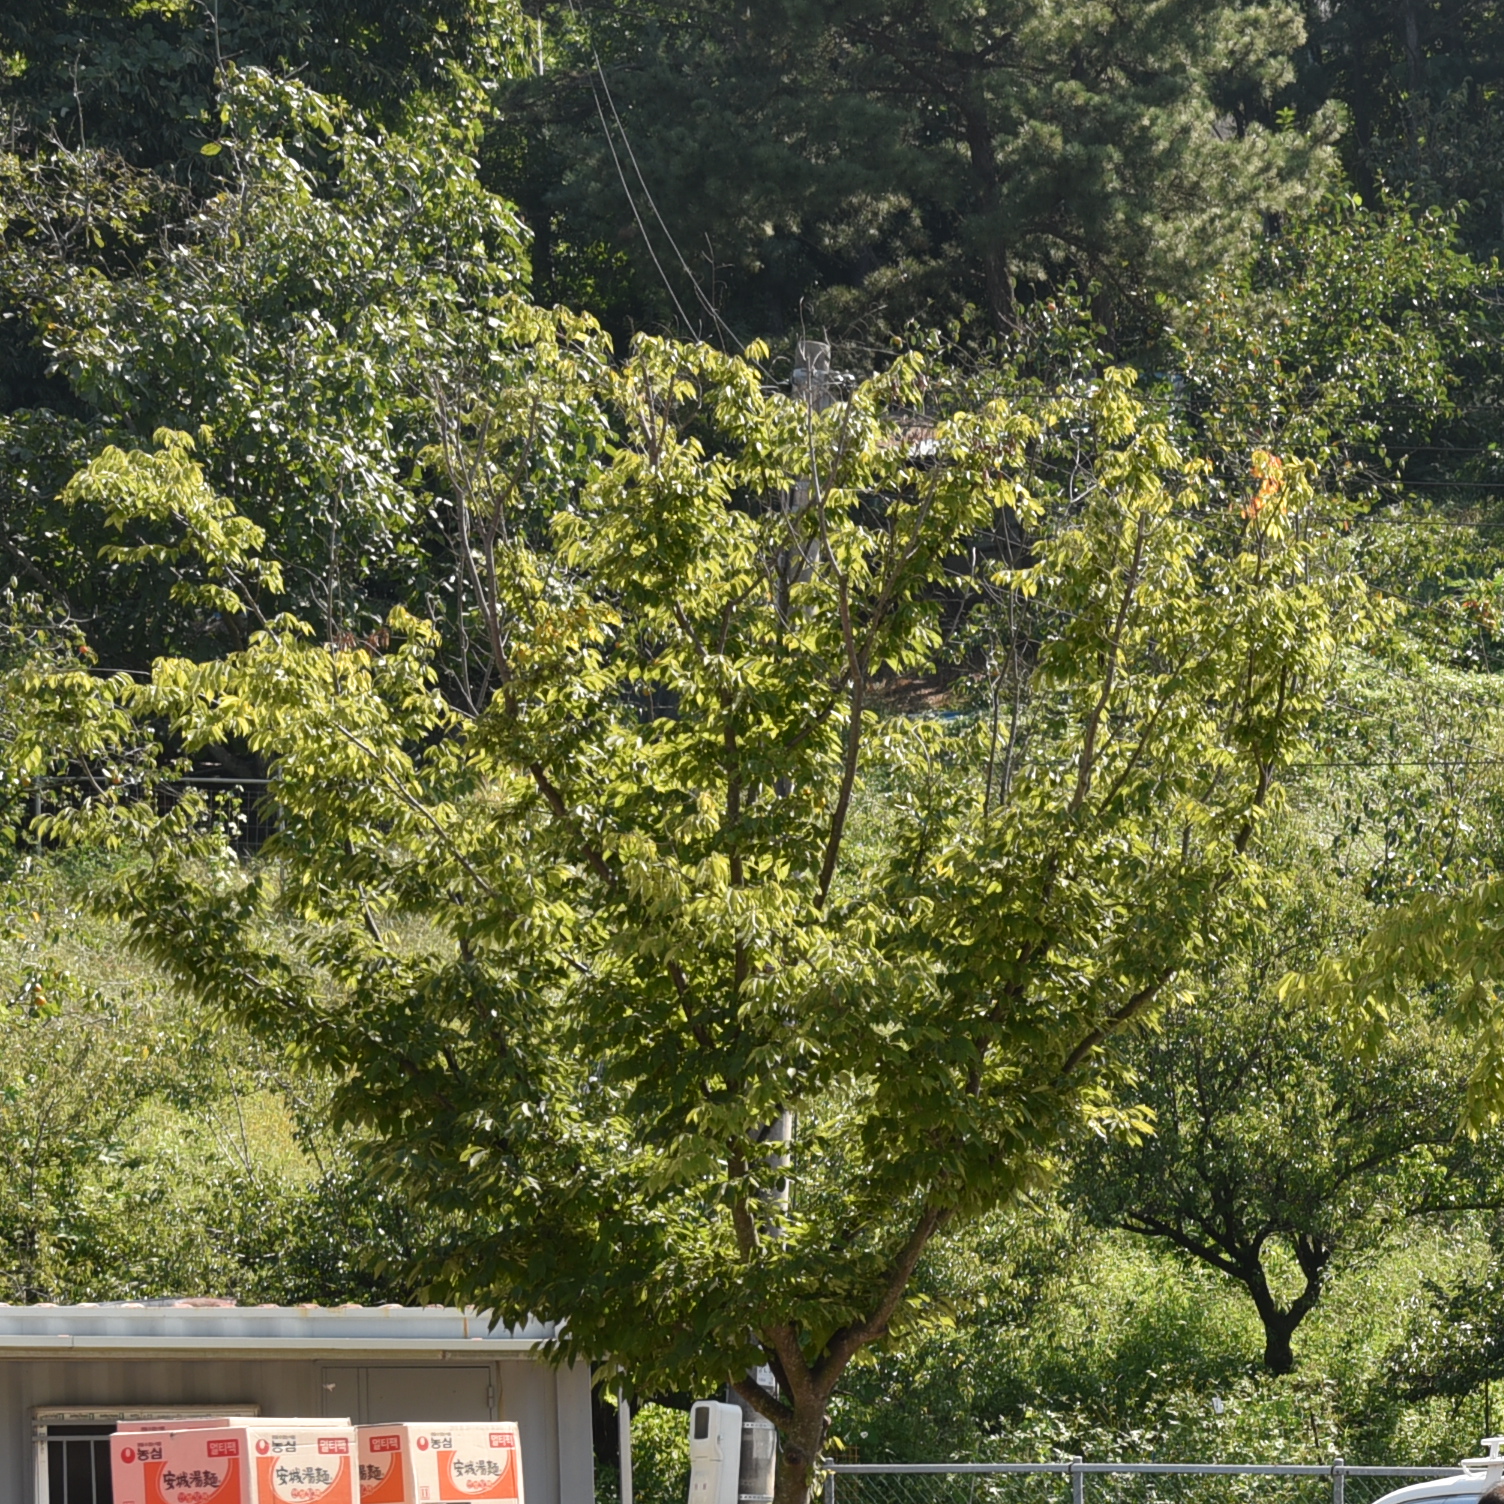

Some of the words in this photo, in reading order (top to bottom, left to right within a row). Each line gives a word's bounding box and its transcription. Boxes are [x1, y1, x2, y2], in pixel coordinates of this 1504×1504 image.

[270, 1440, 297, 1453] 농심
[319, 1439, 348, 1454] 멀티팩
[371, 1437, 399, 1450] 멀티팩
[430, 1436, 453, 1448] 농심
[490, 1434, 515, 1447] 멀티팩
[136, 1448, 163, 1461] 농심
[209, 1441, 239, 1455] 멀티팩
